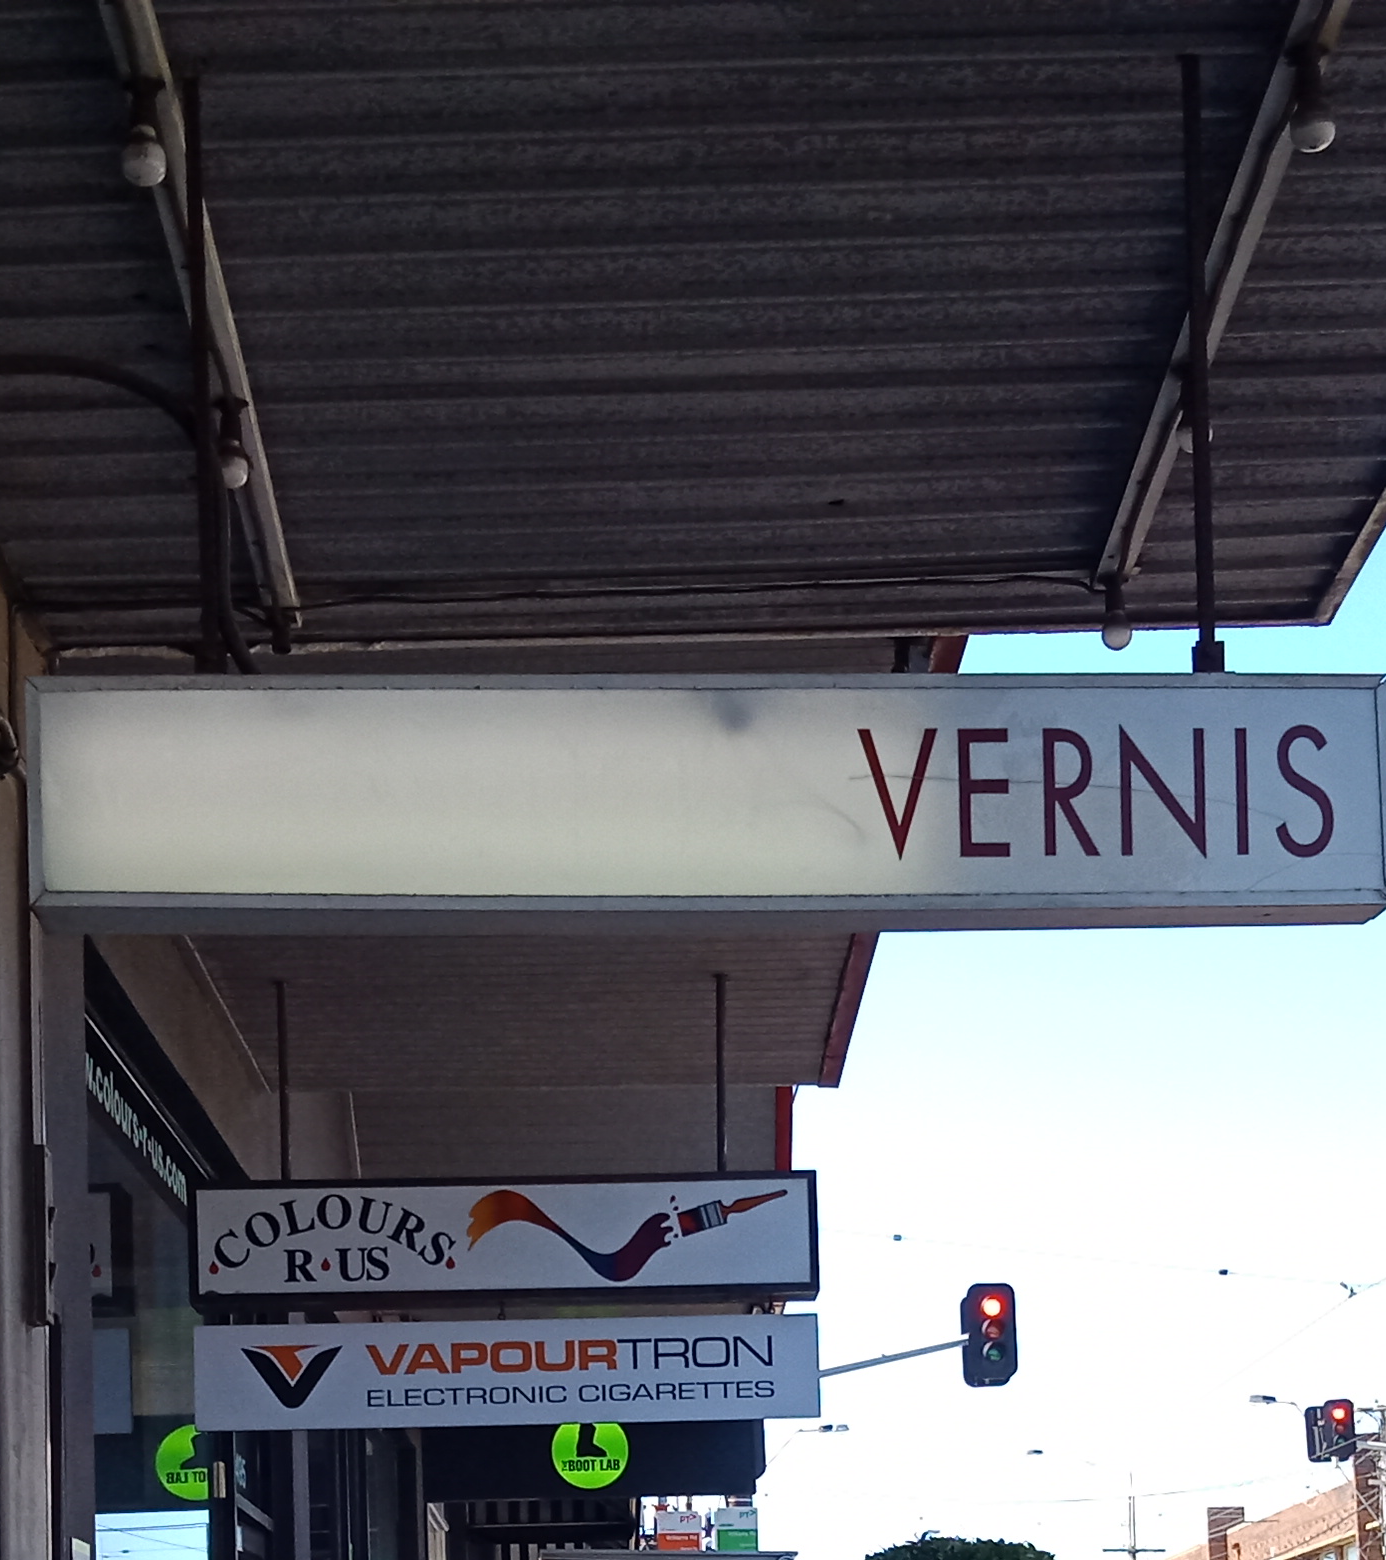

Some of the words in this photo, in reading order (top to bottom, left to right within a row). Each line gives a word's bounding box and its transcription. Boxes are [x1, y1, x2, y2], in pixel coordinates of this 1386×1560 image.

[857, 723, 1335, 860] VERNIS
[214, 1194, 457, 1268] COLOURS
[365, 1336, 774, 1375] VAPOURTRON
[366, 1384, 568, 1408] ELECTRONIC
[577, 1380, 776, 1403] CIGARETTES
[568, 1459, 597, 1472] BOOT
[599, 1459, 620, 1471] LAB
